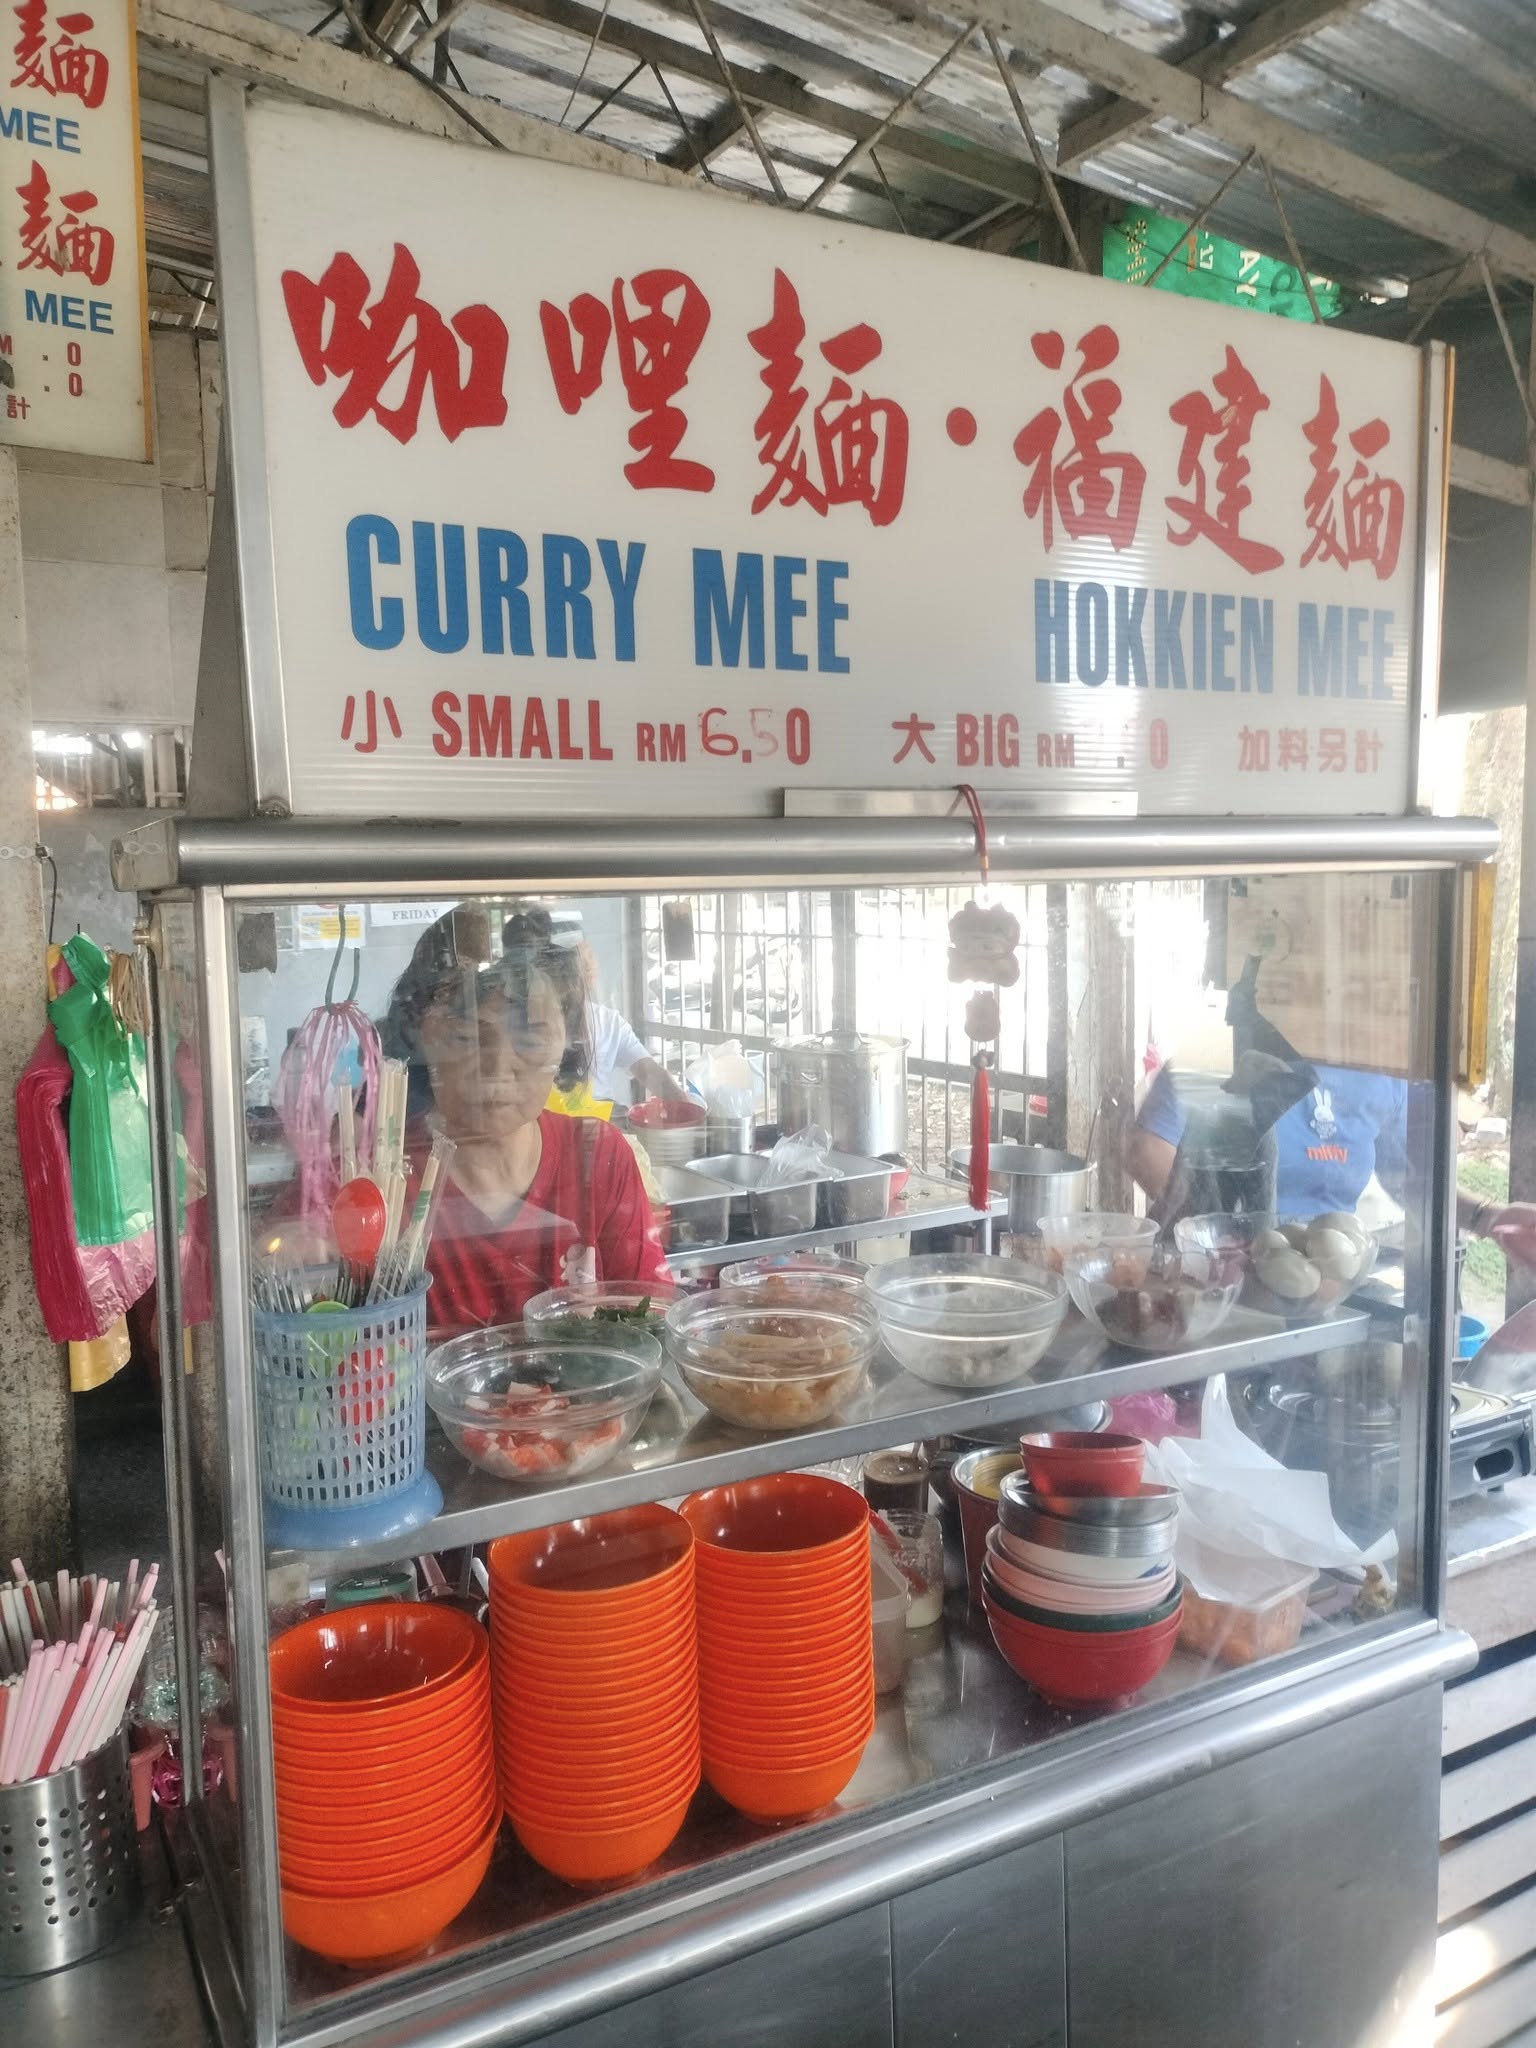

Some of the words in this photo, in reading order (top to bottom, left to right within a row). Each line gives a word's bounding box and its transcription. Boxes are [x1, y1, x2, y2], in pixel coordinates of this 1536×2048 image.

[0, 105, 81, 154] MEE
[16, 160, 115, 286] 麵
[25, 289, 114, 335] MEE
[345, 513, 646, 662] CURRY
[692, 547, 850, 674] MEE
[1034, 578, 1274, 694] HOKKIEN
[1298, 602, 1395, 699] MEE
[341, 690, 402, 753] 小
[431, 690, 614, 762] SMALL
[636, 722, 687, 762] RM
[700, 707, 811, 766] 6.50
[892, 713, 936, 764] 大
[956, 714, 1020, 768] BIG
[1037, 733, 1075, 769] RM
[392, 908, 439, 921] FRIDAY
